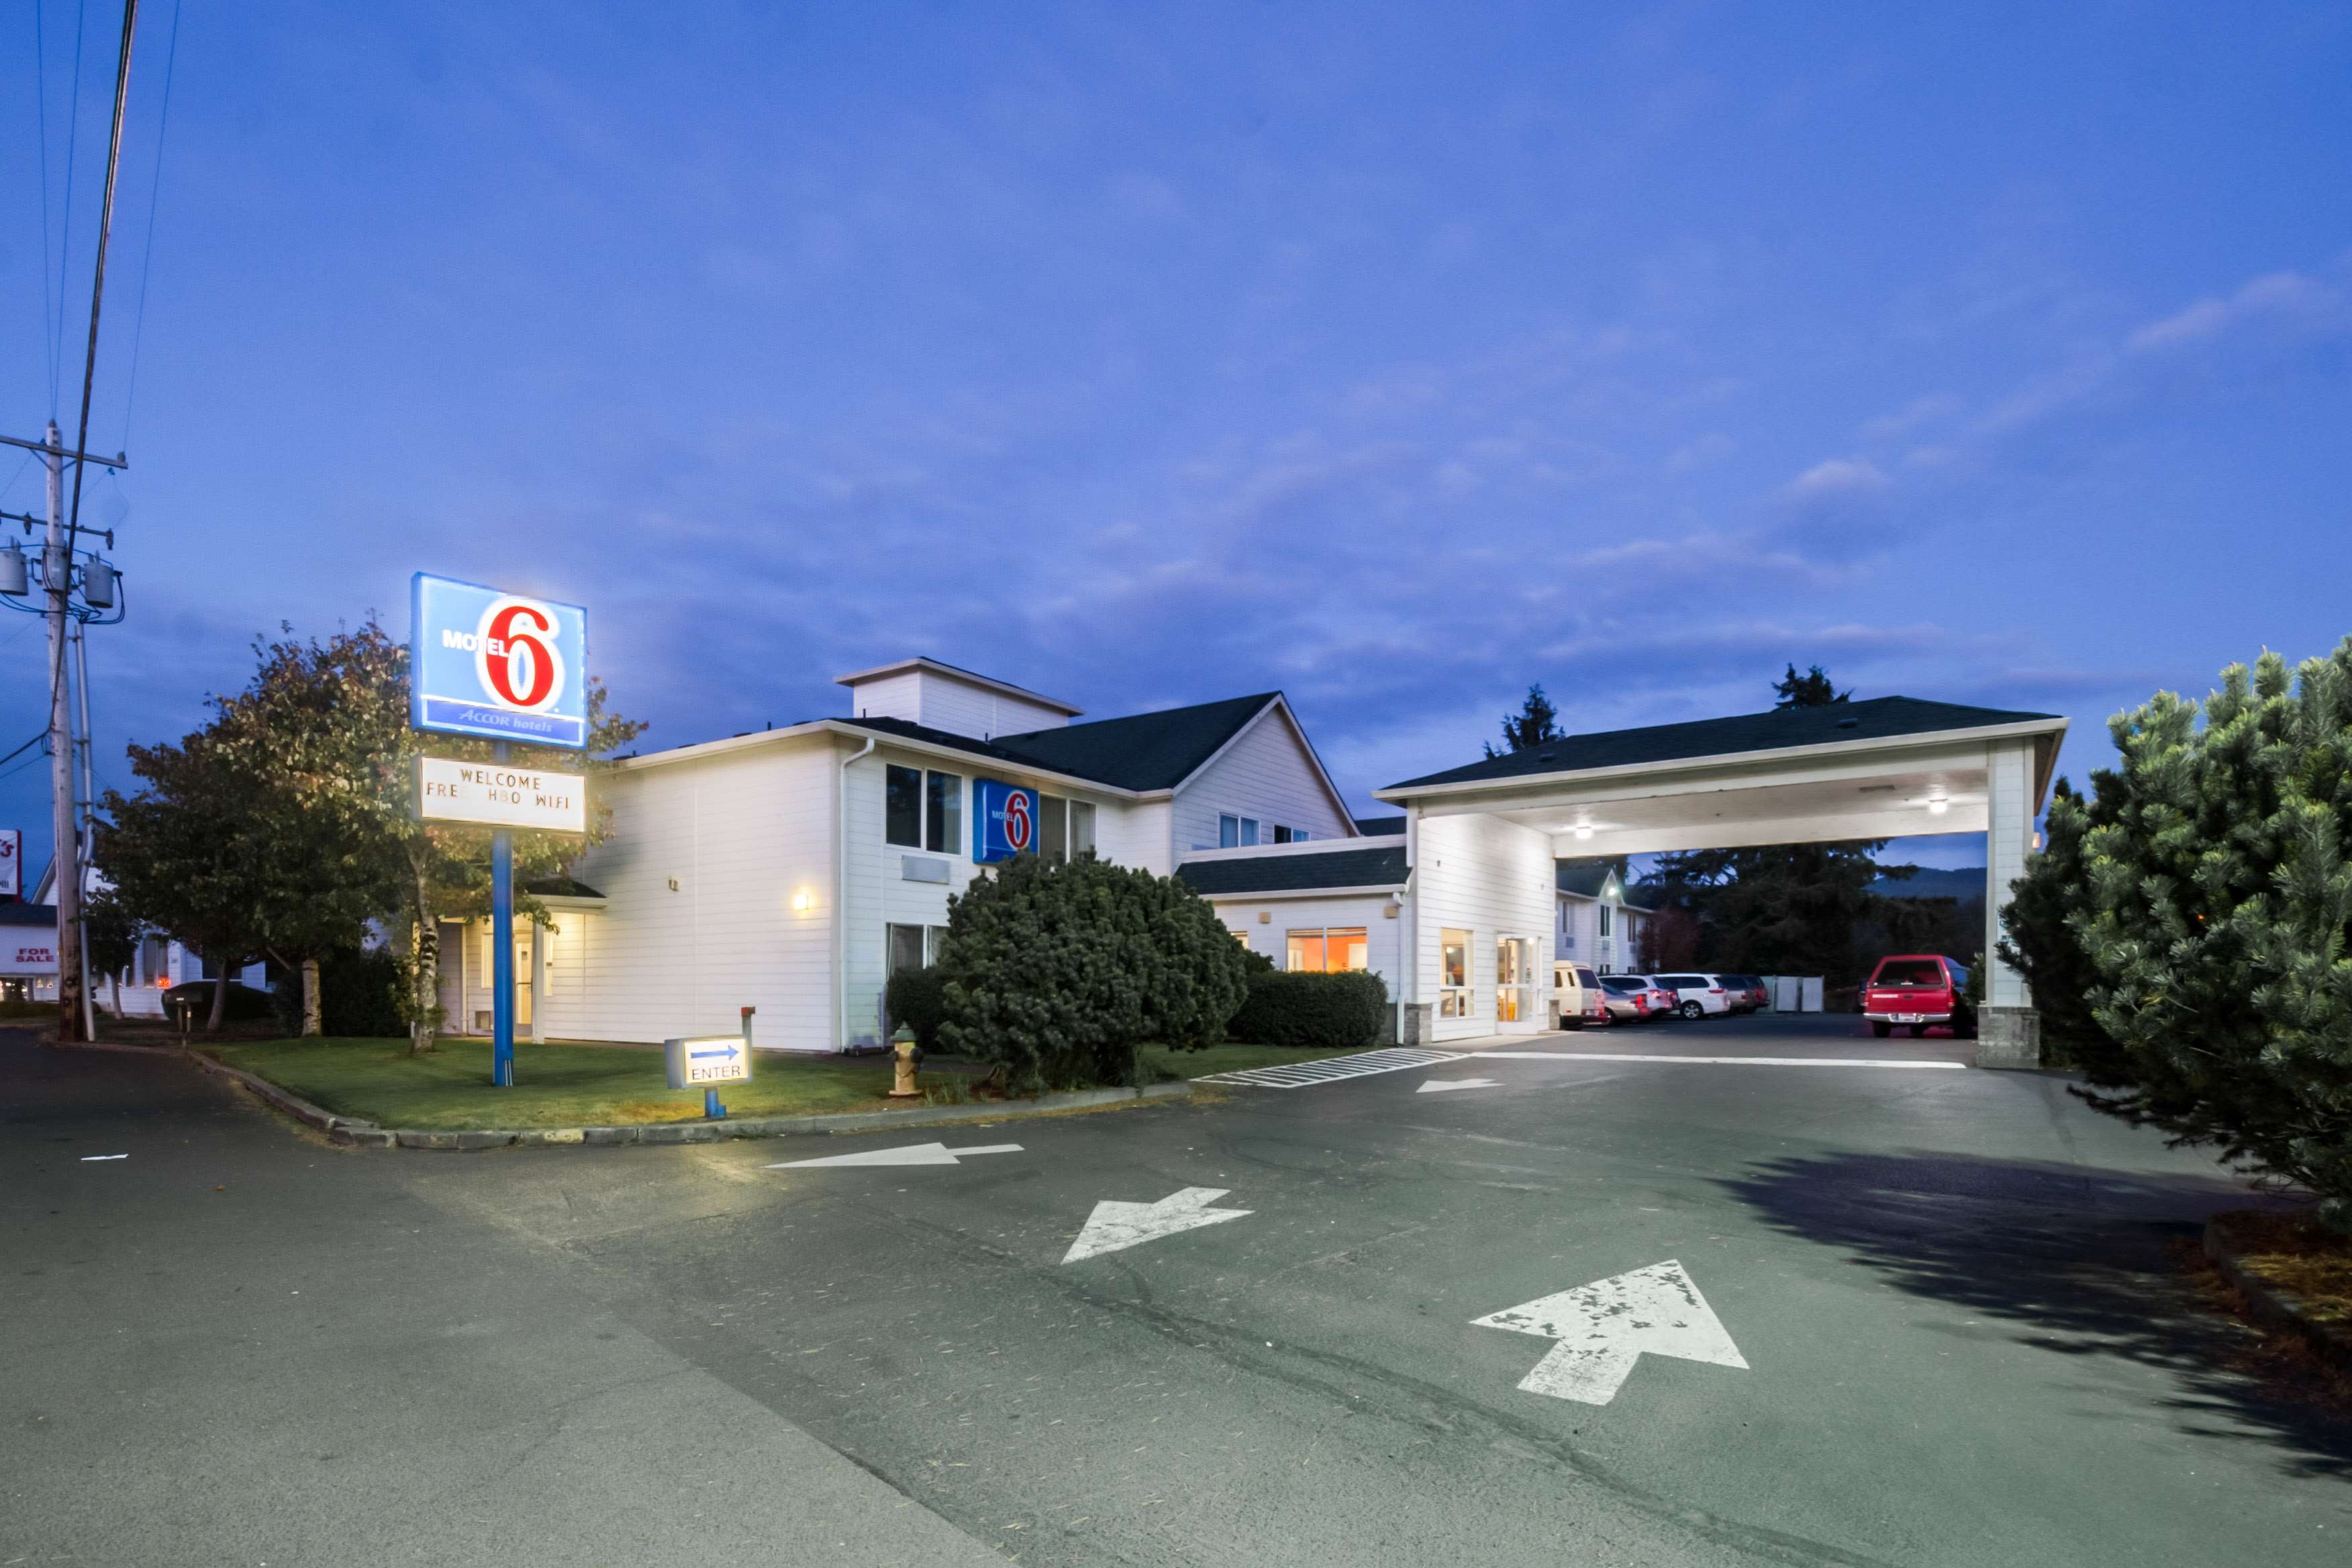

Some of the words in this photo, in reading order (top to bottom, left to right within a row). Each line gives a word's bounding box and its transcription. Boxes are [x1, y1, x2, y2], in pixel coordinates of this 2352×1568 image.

[442, 629, 509, 658] MOTEL
[486, 605, 554, 707] 6
[513, 718, 553, 732] hotels
[460, 769, 542, 790] WELCOME
[536, 794, 569, 809] WIFI
[991, 810, 1016, 822] MOTEL
[1006, 792, 1030, 849] 6
[692, 1065, 740, 1080] ENTER
